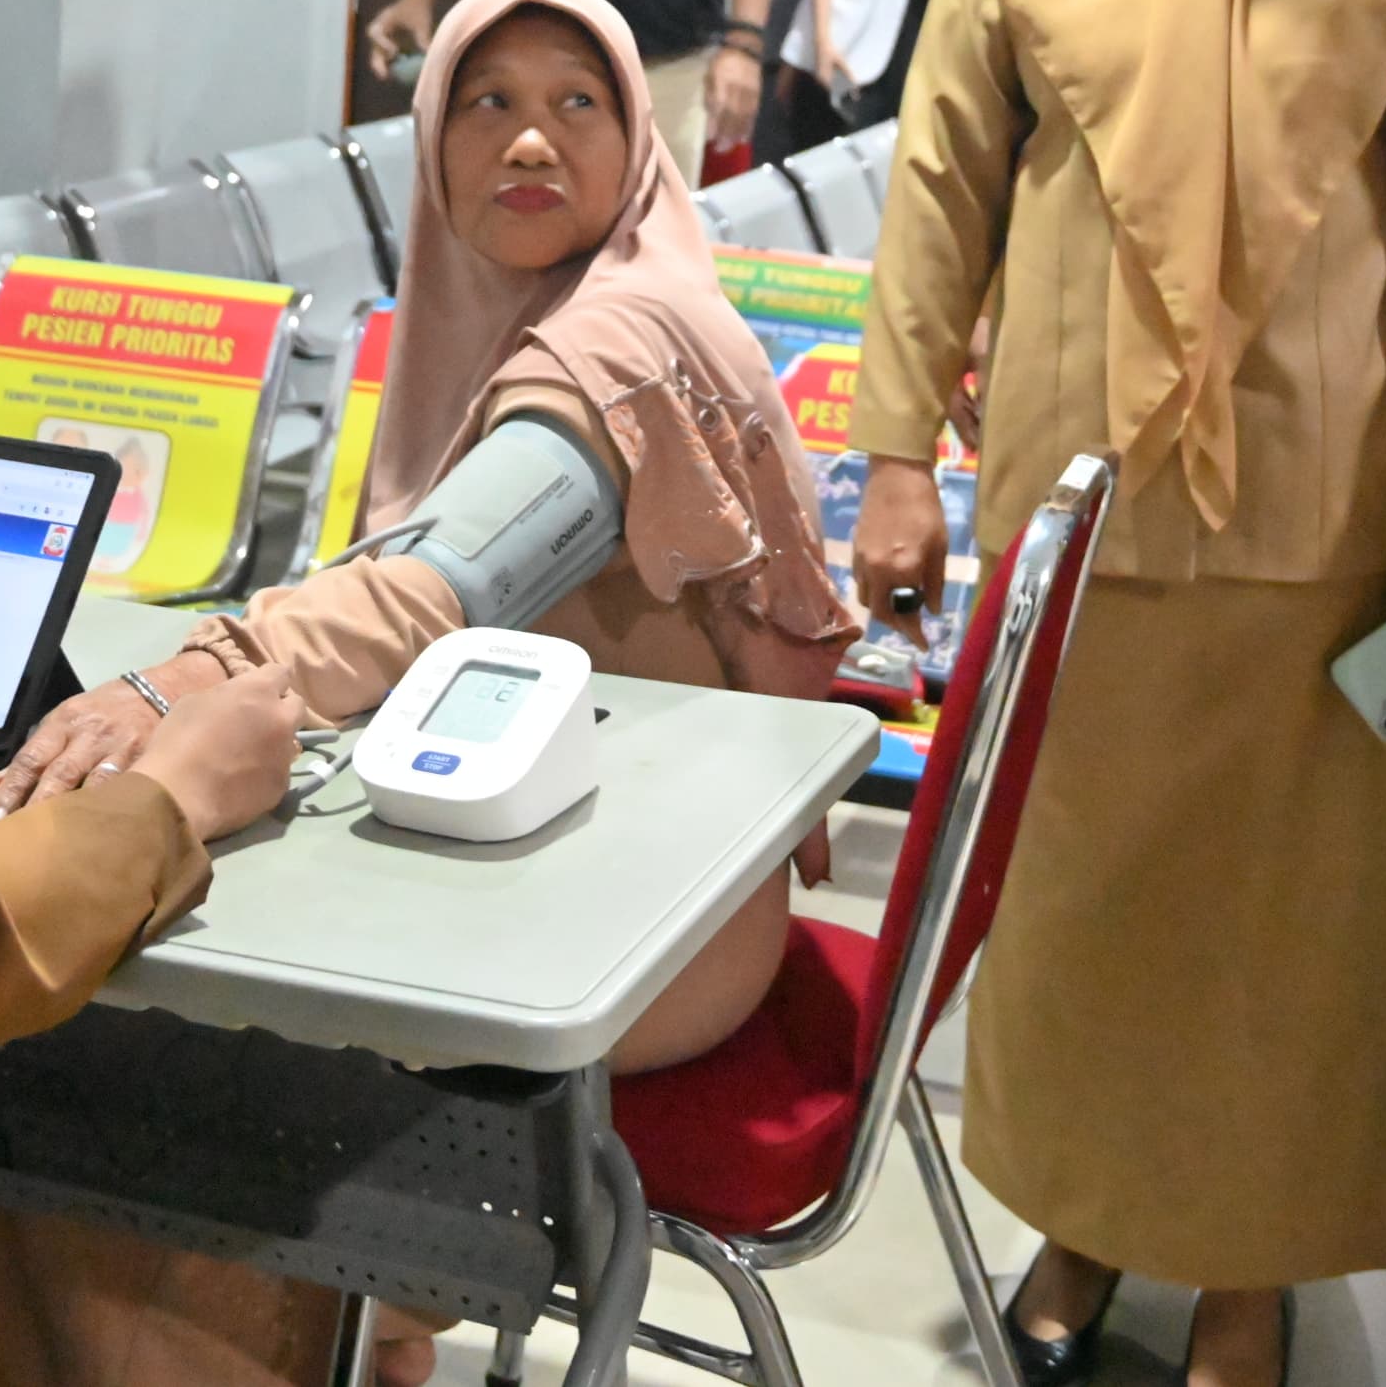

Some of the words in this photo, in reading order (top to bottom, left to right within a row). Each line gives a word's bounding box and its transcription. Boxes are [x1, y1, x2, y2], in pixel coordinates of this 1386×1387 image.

[50, 285, 123, 317] KURSI
[128, 293, 224, 330] TUNGGU
[20, 313, 106, 348] PESIEN
[109, 323, 236, 366] PRIORITAS
